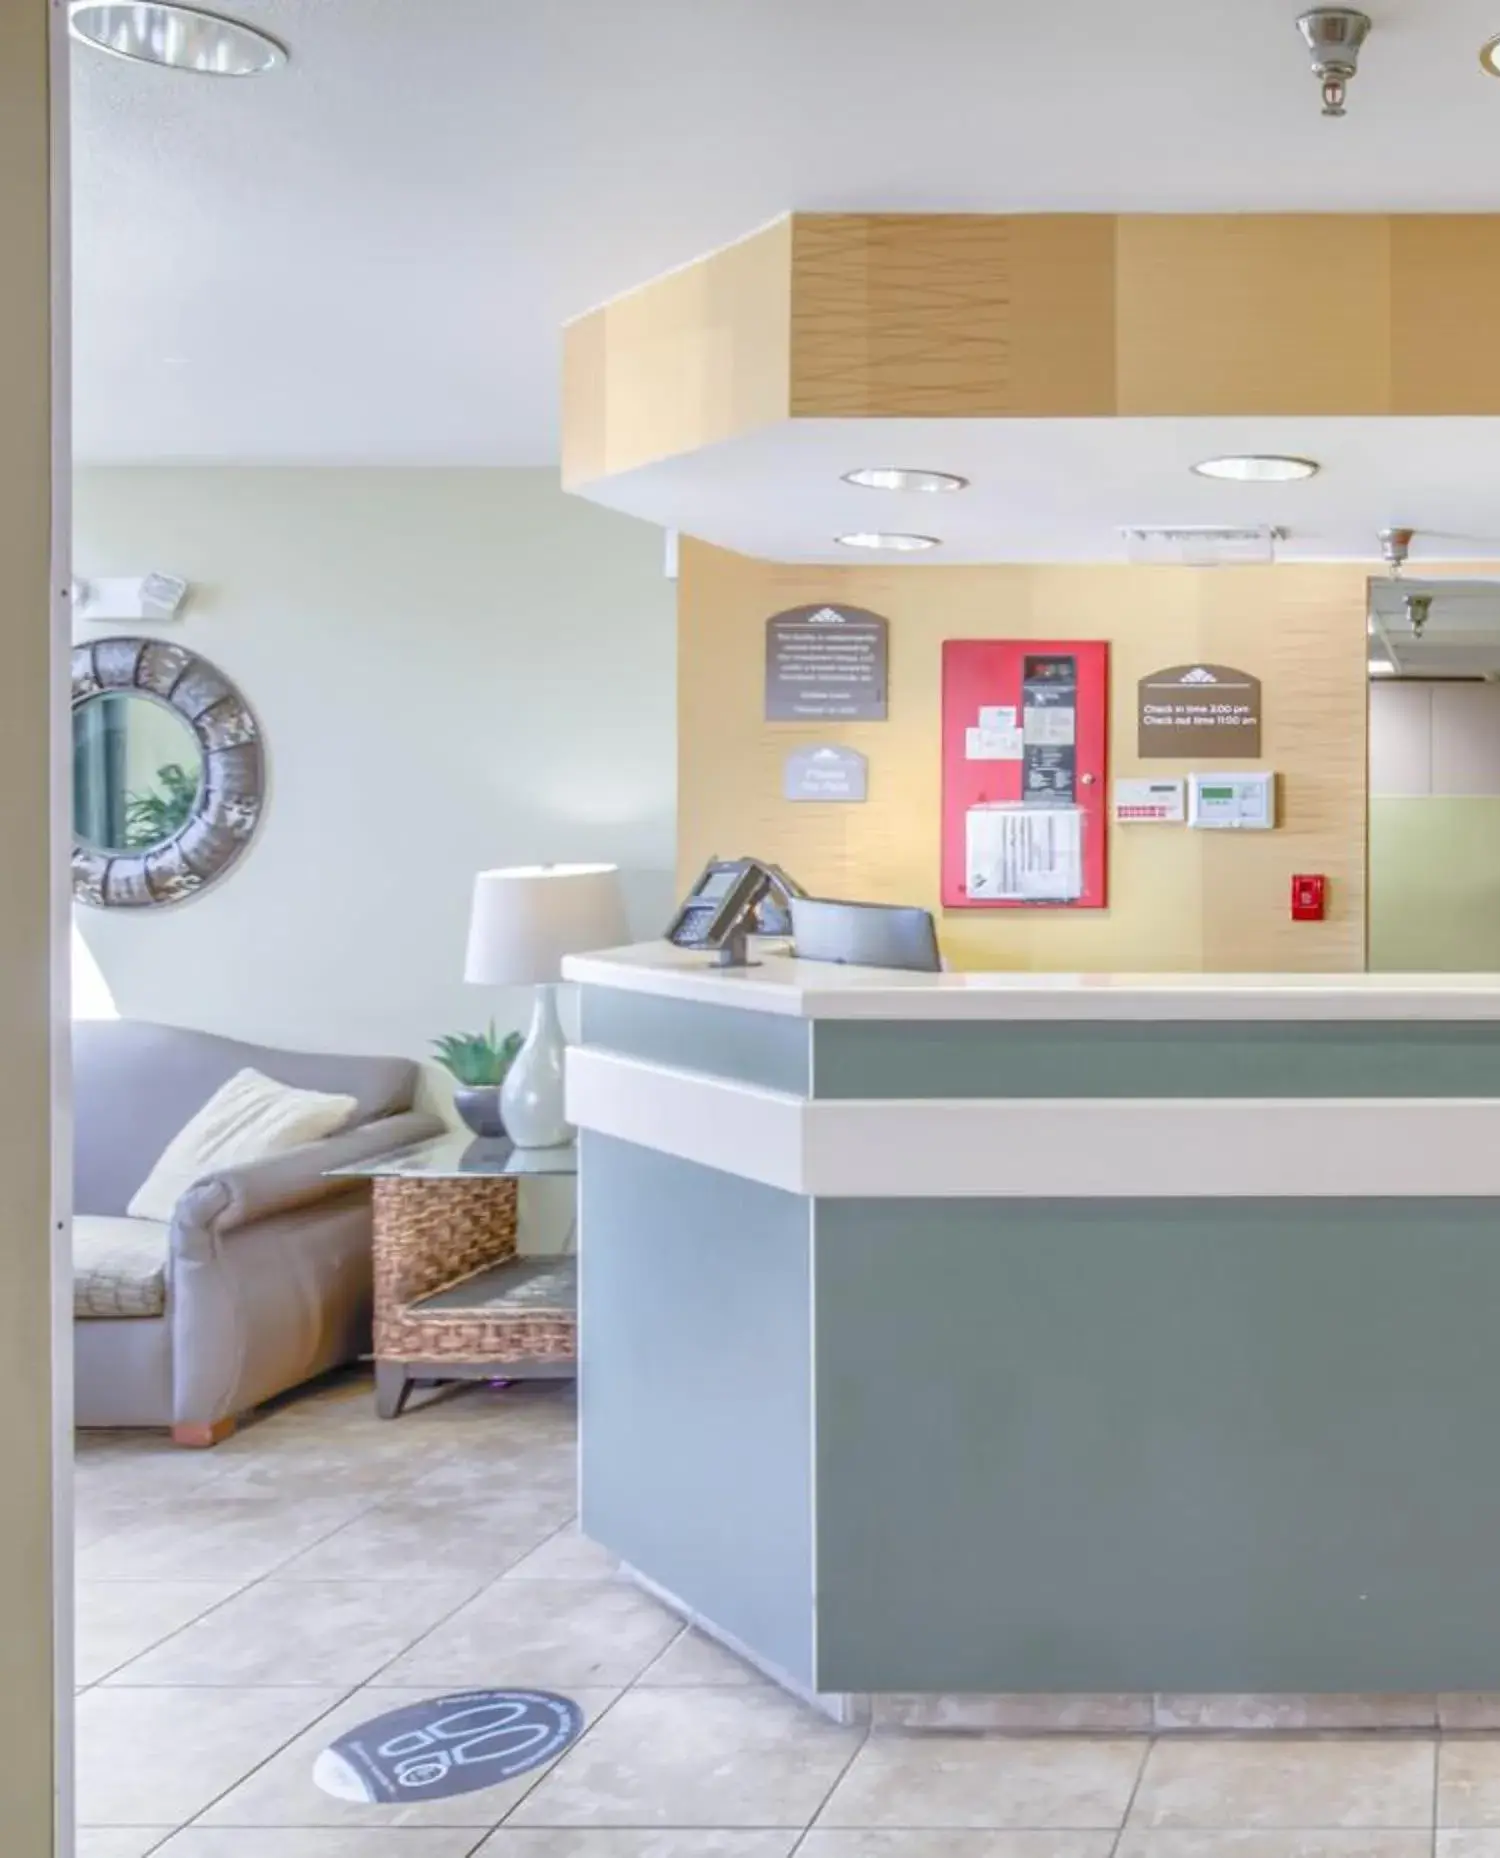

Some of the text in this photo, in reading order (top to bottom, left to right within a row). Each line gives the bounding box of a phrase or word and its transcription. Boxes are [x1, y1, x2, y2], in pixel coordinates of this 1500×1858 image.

[1144, 704, 1172, 714] Check
[1175, 704, 1185, 713] in
[1186, 704, 1208, 714] time
[1144, 715, 1172, 725] Check
[1174, 716, 1192, 725] out
[1193, 716, 1215, 725] time
